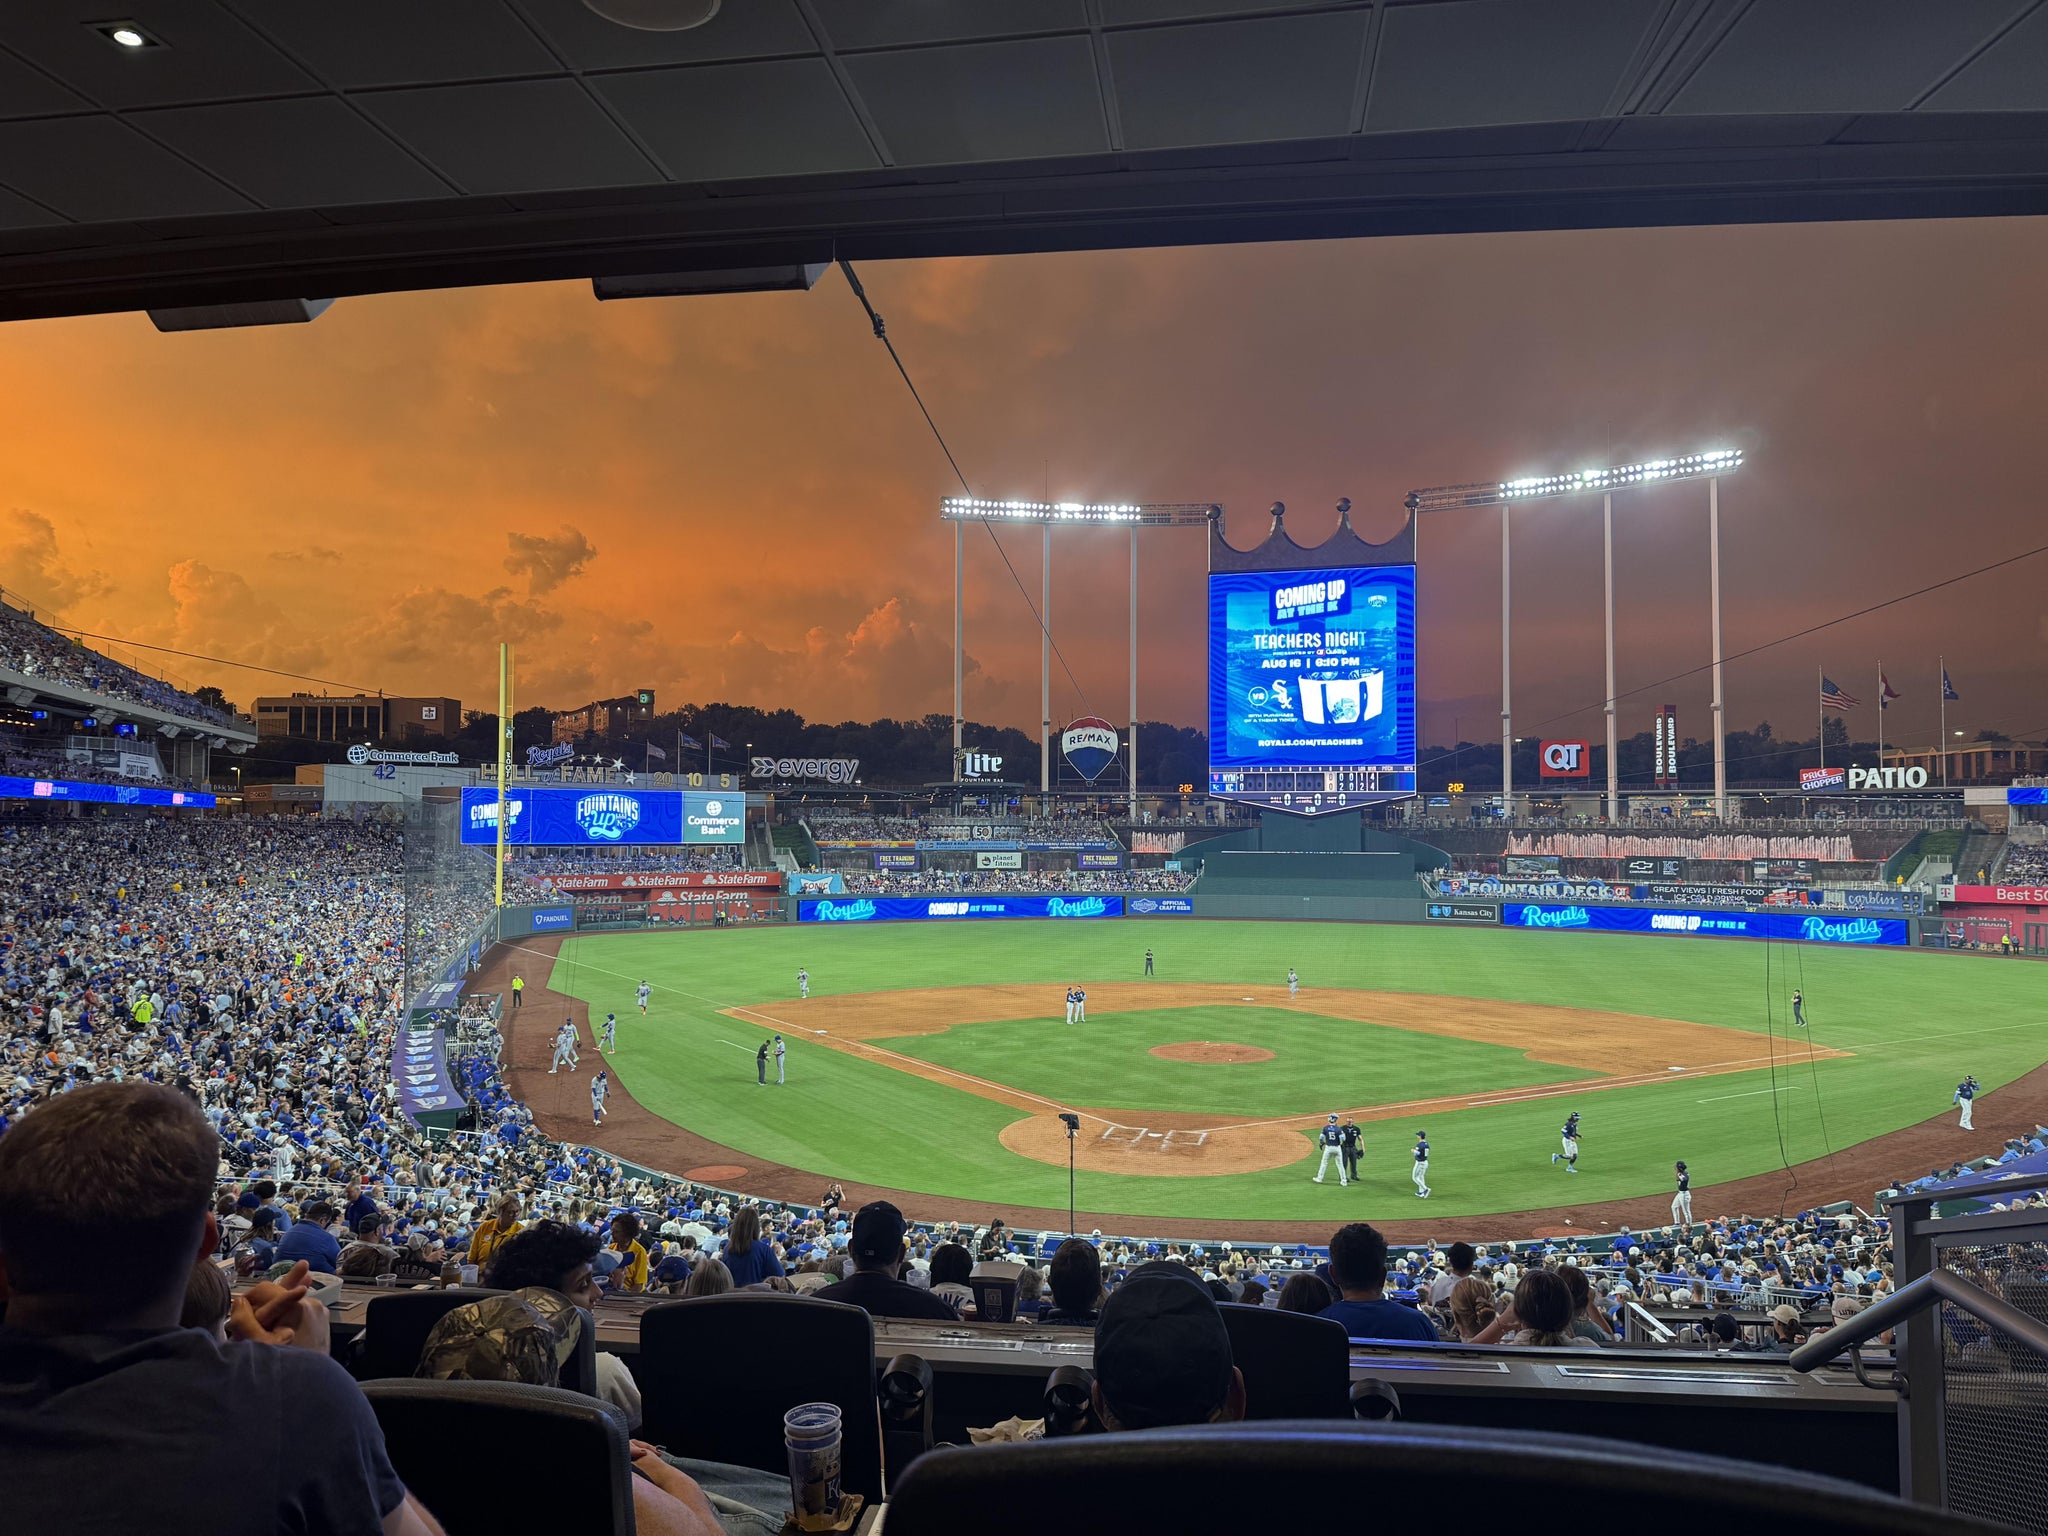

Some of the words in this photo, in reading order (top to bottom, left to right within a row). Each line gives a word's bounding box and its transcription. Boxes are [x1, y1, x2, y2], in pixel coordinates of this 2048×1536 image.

[1276, 582, 1326, 608] COMING
[1328, 579, 1346, 600] UP
[1276, 606, 1294, 620] AT
[1298, 604, 1324, 616] THE
[1327, 601, 1338, 612] K
[1253, 632, 1321, 650] TEACHERS
[1326, 631, 1366, 647] NIGHT
[1262, 660, 1287, 668] AUG
[1290, 659, 1302, 668] 16
[1315, 658, 1339, 668] 6:10
[1341, 657, 1360, 666] PM
[1070, 734, 1110, 745] RE/MAX
[1258, 738, 1363, 747] ROYALS.COM/TEACHERS
[1668, 717, 1676, 774] BOULEVARD
[370, 751, 428, 764] Commerce
[430, 752, 459, 764] Bank
[527, 741, 574, 766] Royals
[1544, 744, 1582, 771] QT
[780, 759, 858, 782] evergy
[964, 752, 1002, 778] Lite
[372, 765, 396, 780] 42
[480, 763, 538, 782] HLL
[561, 766, 618, 784] FAME
[654, 772, 674, 786] 20
[1802, 769, 1827, 781] PRICE
[1848, 766, 1928, 788] PATIO
[686, 772, 702, 788] 10
[720, 774, 730, 788] 5
[1802, 776, 1844, 790] CHOPPER
[1179, 784, 1193, 793] 2:02
[1448, 783, 1464, 792] 2:02
[1284, 794, 1291, 805] 0
[1315, 794, 1321, 806] 0
[1339, 794, 1346, 806] 0
[578, 796, 639, 820] FOUNTAINS
[589, 810, 621, 838] up
[688, 815, 740, 826] Commerce
[701, 826, 726, 835] Bank
[992, 855, 1012, 863] planet
[803, 882, 828, 890] SONIC
[1470, 883, 1557, 896] FOUNTAIN
[1564, 886, 1611, 898] DECK
[1941, 888, 1951, 898] T
[1849, 892, 1898, 905] carbliss
[1997, 888, 2030, 900] Best
[815, 899, 876, 920] Royals
[929, 903, 958, 915] COMING
[958, 902, 969, 915] UP
[1047, 897, 1106, 916] Royals
[1479, 910, 1493, 918] City
[1520, 905, 1590, 926] Royals
[1652, 914, 1686, 930] COMING
[1687, 916, 1700, 930] UP
[1801, 917, 1882, 941] Royals
